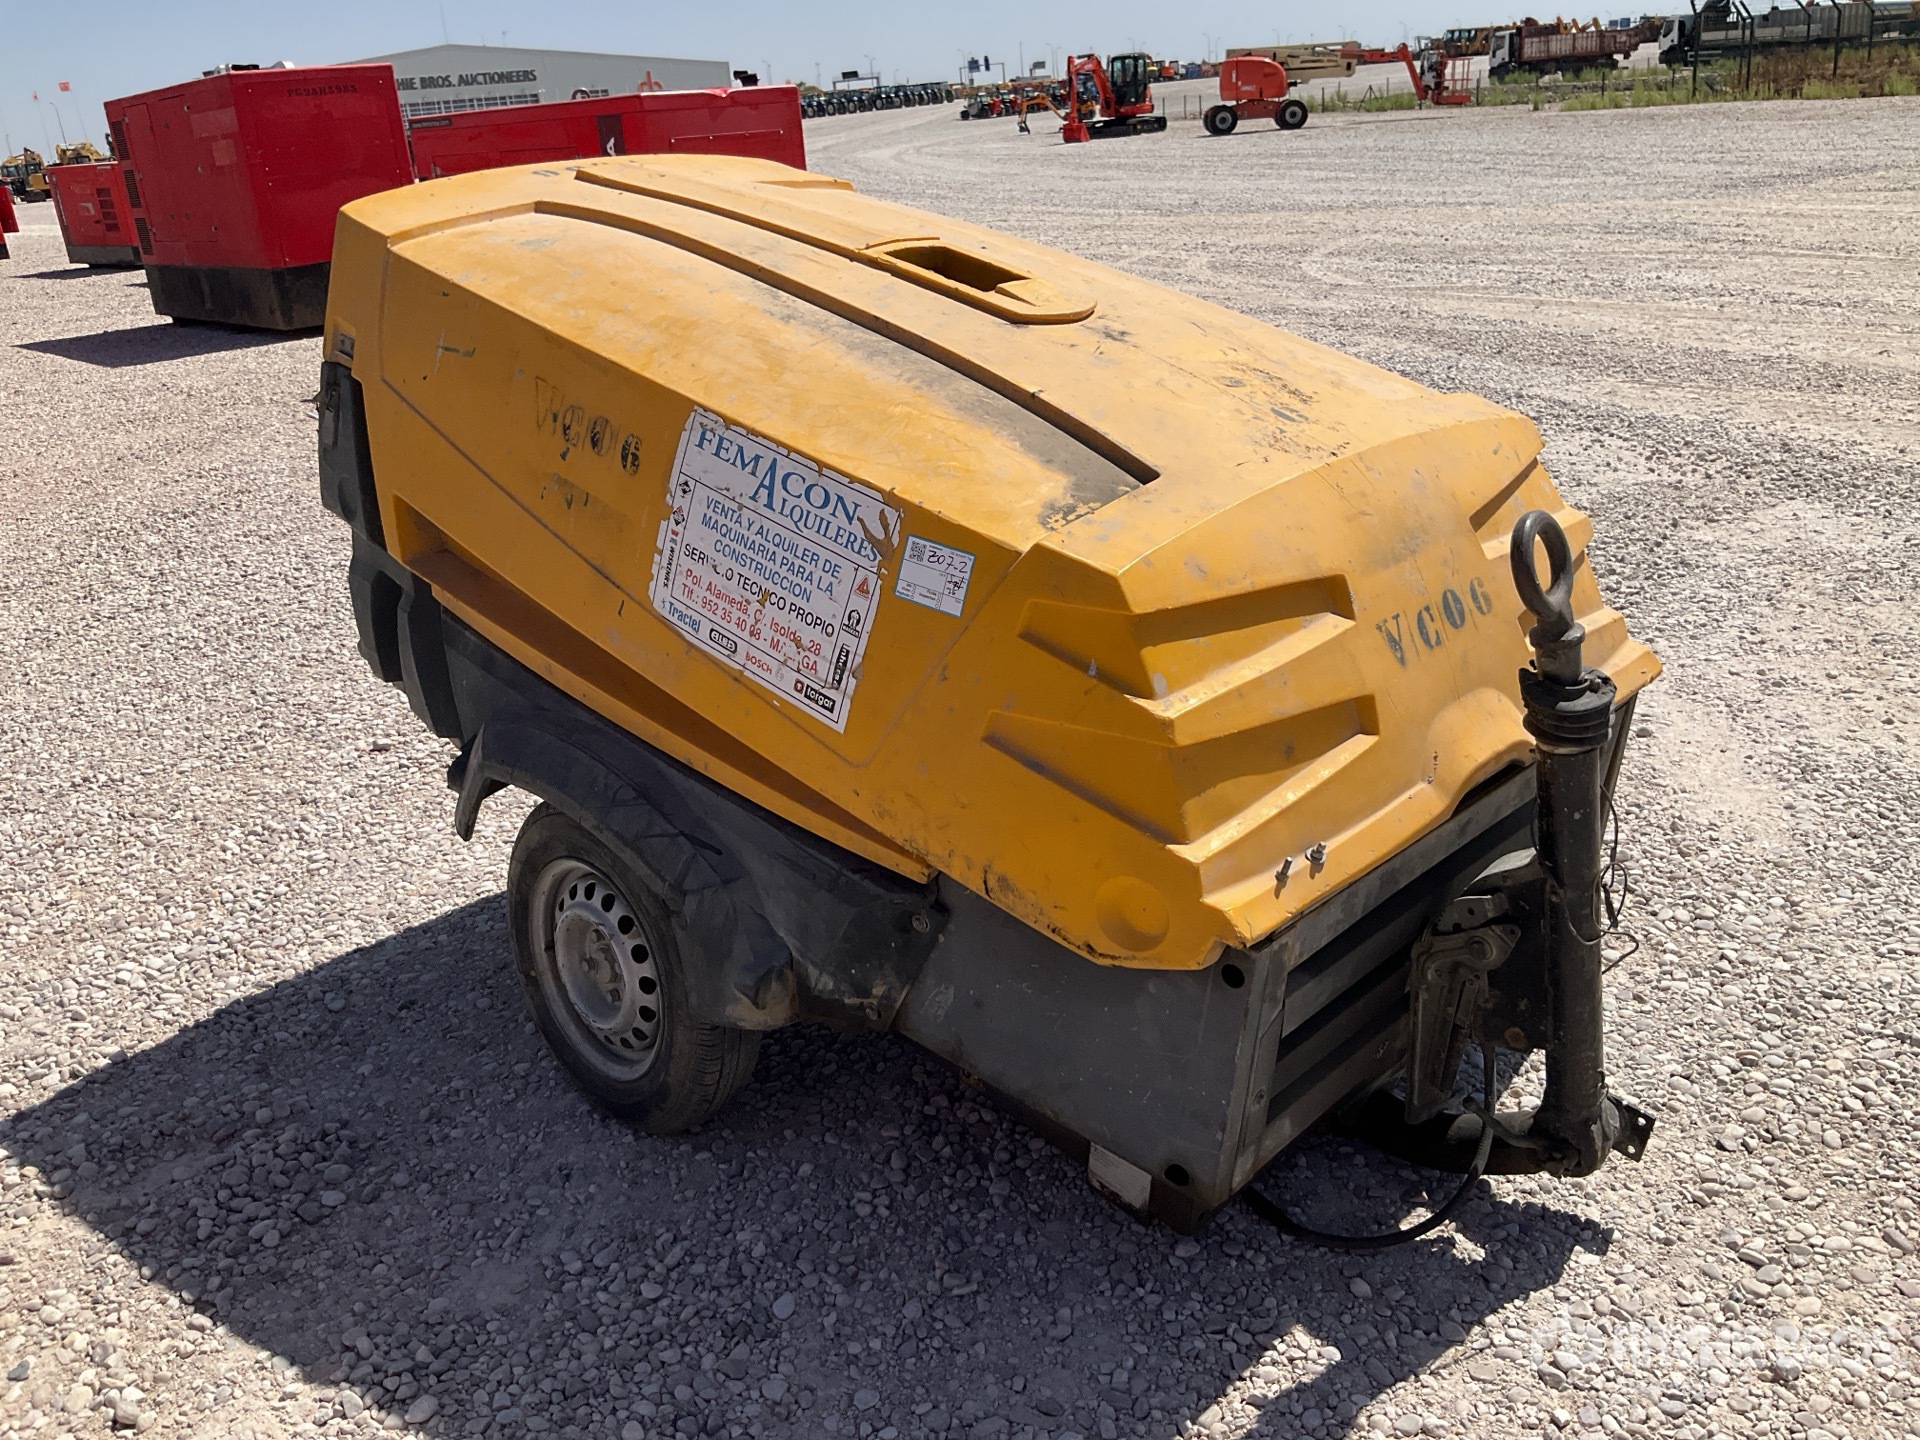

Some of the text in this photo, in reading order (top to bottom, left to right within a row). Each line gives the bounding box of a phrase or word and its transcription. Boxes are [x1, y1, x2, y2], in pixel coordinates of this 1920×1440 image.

[420, 74, 456, 90] BROS.
[458, 69, 537, 88] AUCTIONEERS
[694, 427, 862, 527] FEMACON
[701, 512, 834, 597] MAQUINARIA PARA LA
[706, 495, 842, 579] VENTA Y ALQUILER DE
[713, 539, 812, 604] CONSTRUCCION
[667, 600, 702, 634] Tractel
[685, 567, 703, 590] Pol.
[705, 581, 752, 619] Alameda,
[807, 639, 822, 657] 28
[700, 596, 719, 617] 952
[720, 606, 733, 625] 35
[734, 615, 747, 633] 40
[736, 572, 787, 611] TECNCO
[788, 602, 835, 638] PROPIO
